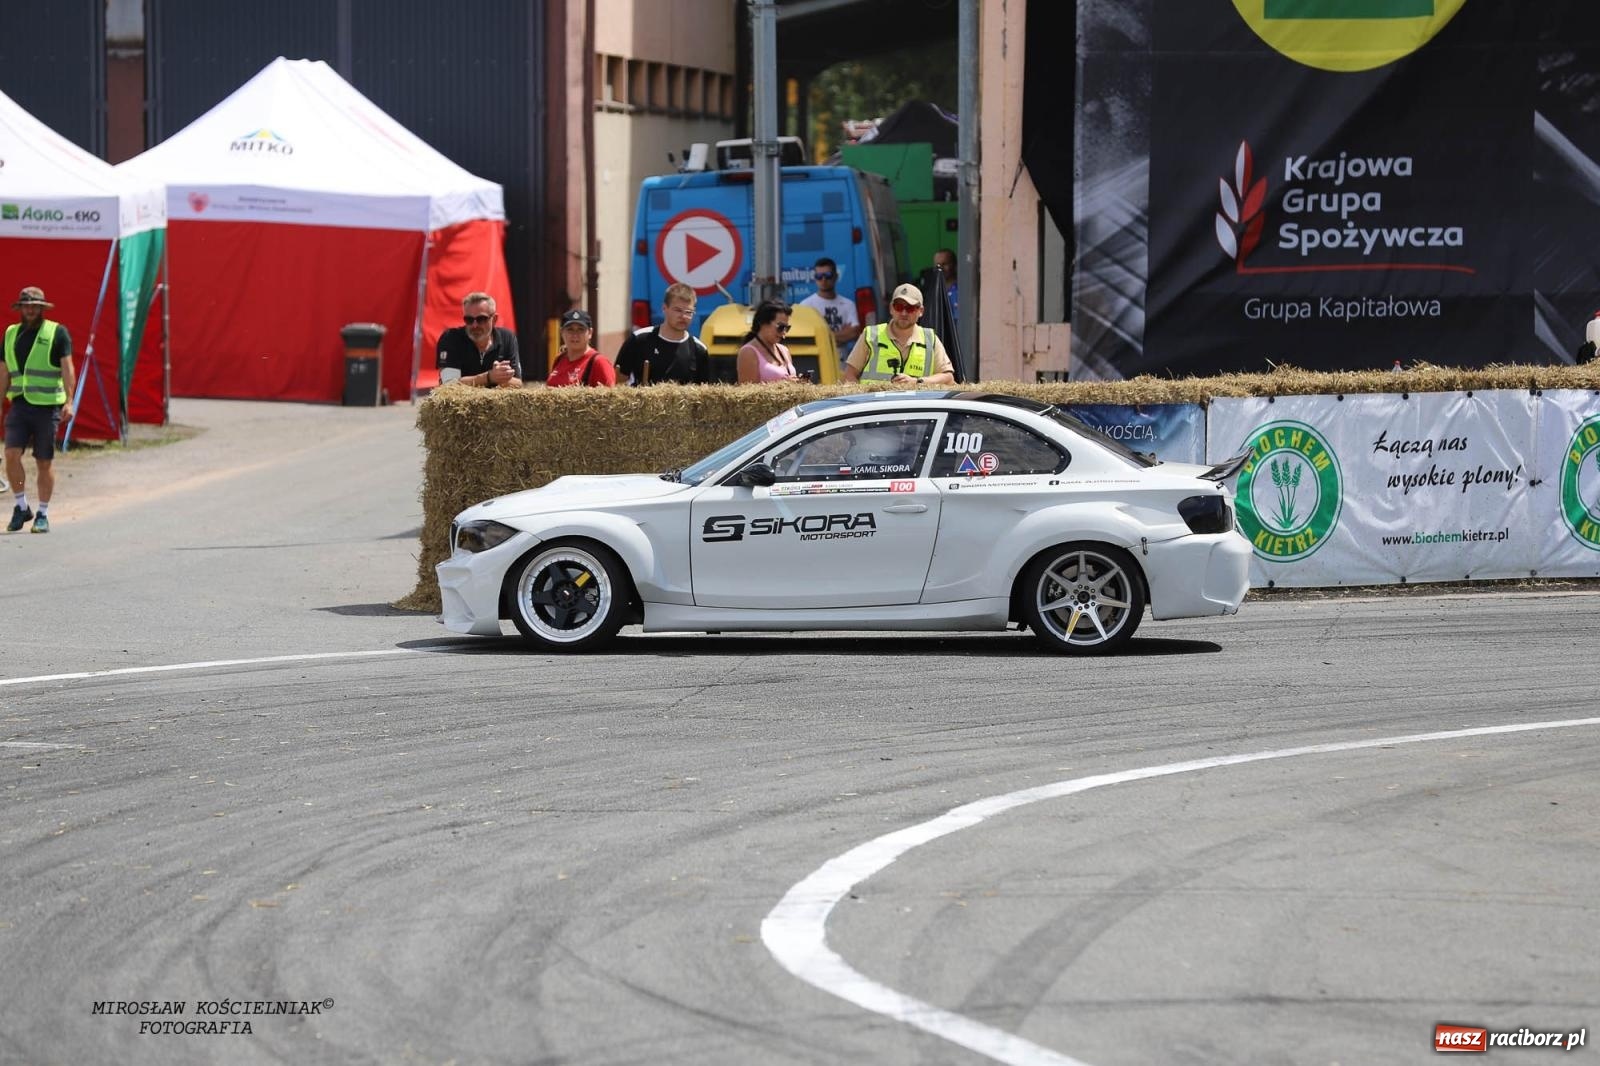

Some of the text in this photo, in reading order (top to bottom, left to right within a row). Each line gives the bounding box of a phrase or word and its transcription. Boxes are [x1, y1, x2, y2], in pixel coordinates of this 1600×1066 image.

[230, 140, 294, 155] MITKO
[1284, 152, 1413, 185] Krajowa
[1282, 189, 1381, 219] Grupa
[1279, 221, 1464, 256] Spożywcza
[1244, 295, 1441, 323] Grupa Kapitałowa
[943, 432, 983, 454] 100
[1373, 430, 1468, 459] Łączą nas
[854, 464, 911, 474] KAMIL SIKORA
[1387, 464, 1522, 495] wysokie plony!
[893, 482, 914, 492] 100
[800, 530, 877, 541] MOTORSPORT
[1254, 526, 1318, 556] KIETRZ
[1382, 528, 1509, 546] www.biochemkietrz.pl
